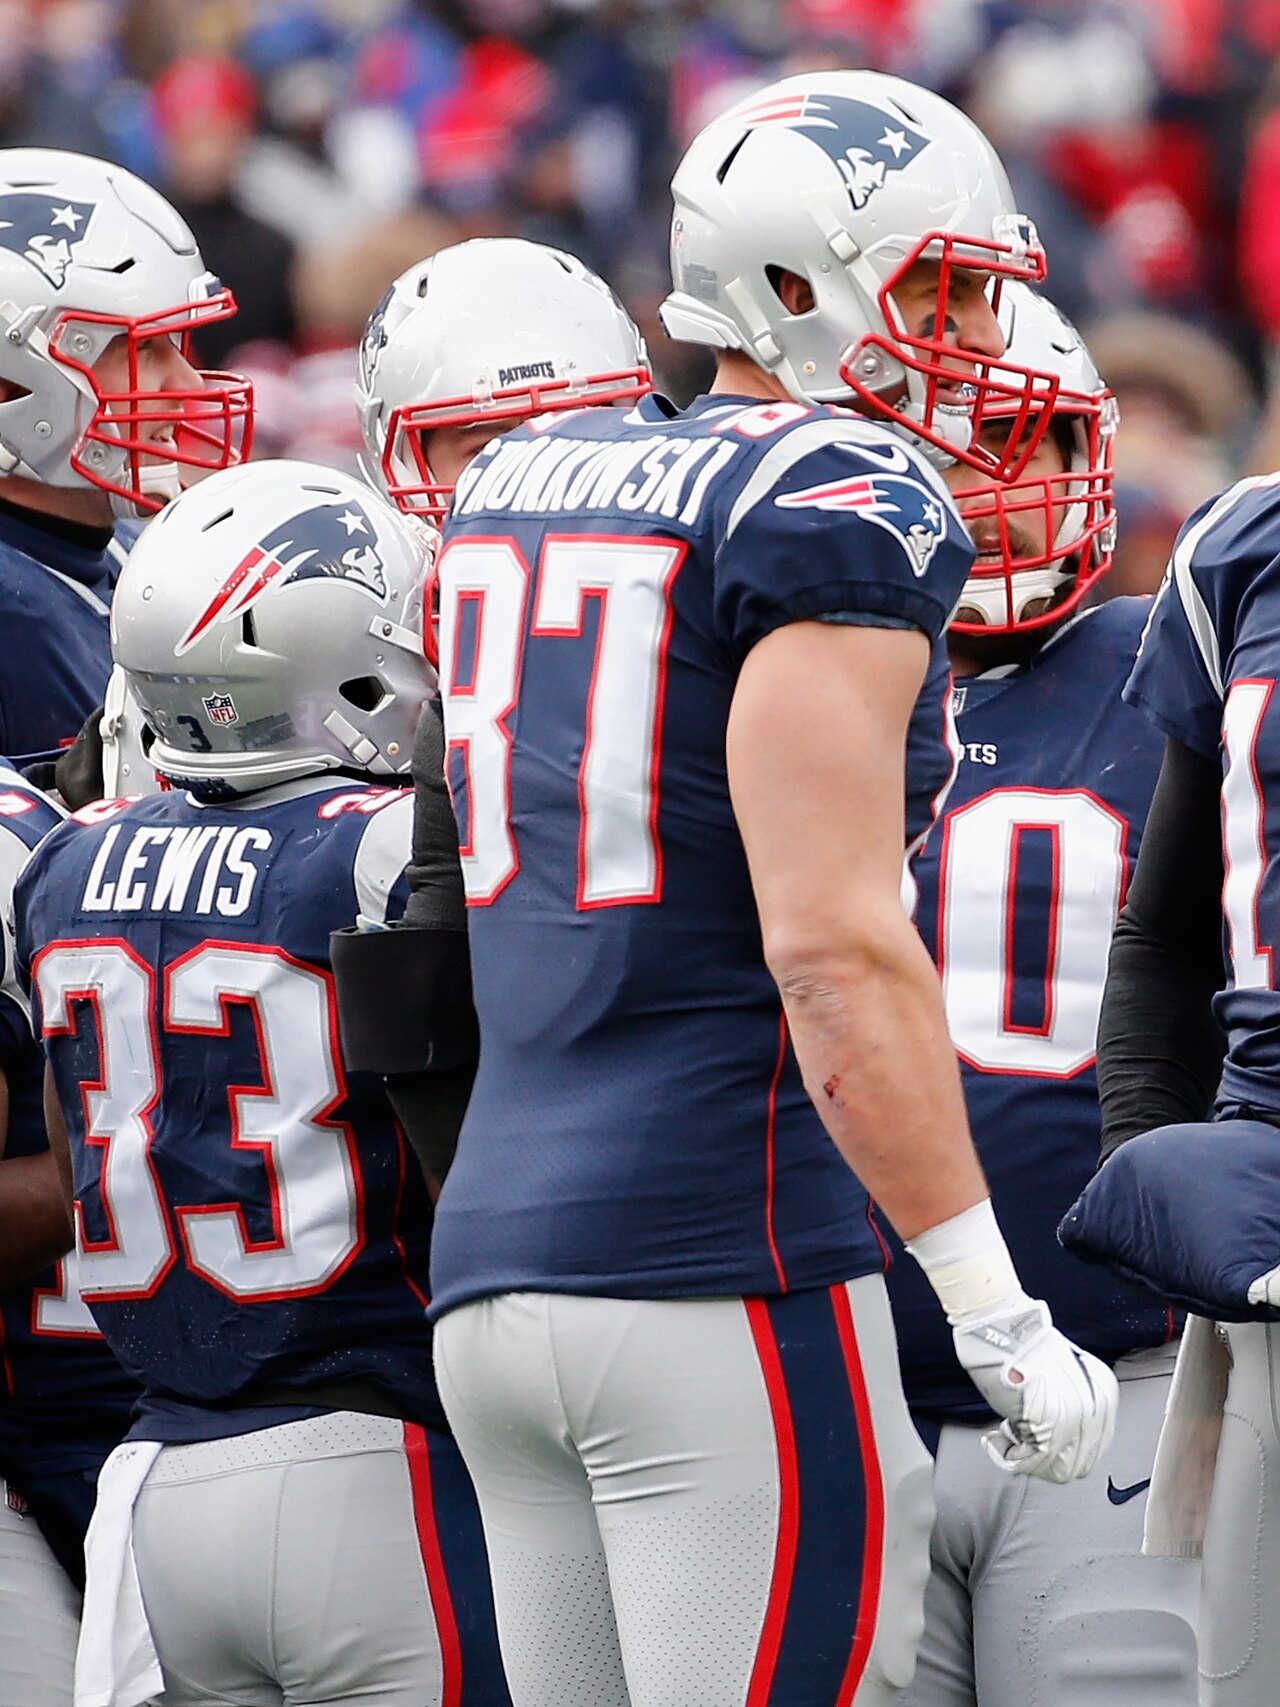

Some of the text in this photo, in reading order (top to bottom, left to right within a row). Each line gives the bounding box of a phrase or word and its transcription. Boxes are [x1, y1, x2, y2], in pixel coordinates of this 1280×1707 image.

[498, 361, 556, 388] PATRIOTS
[210, 707, 235, 723] NFL
[437, 533, 690, 912] 87
[80, 823, 273, 917] LEWIS
[32, 938, 366, 1304] 33
